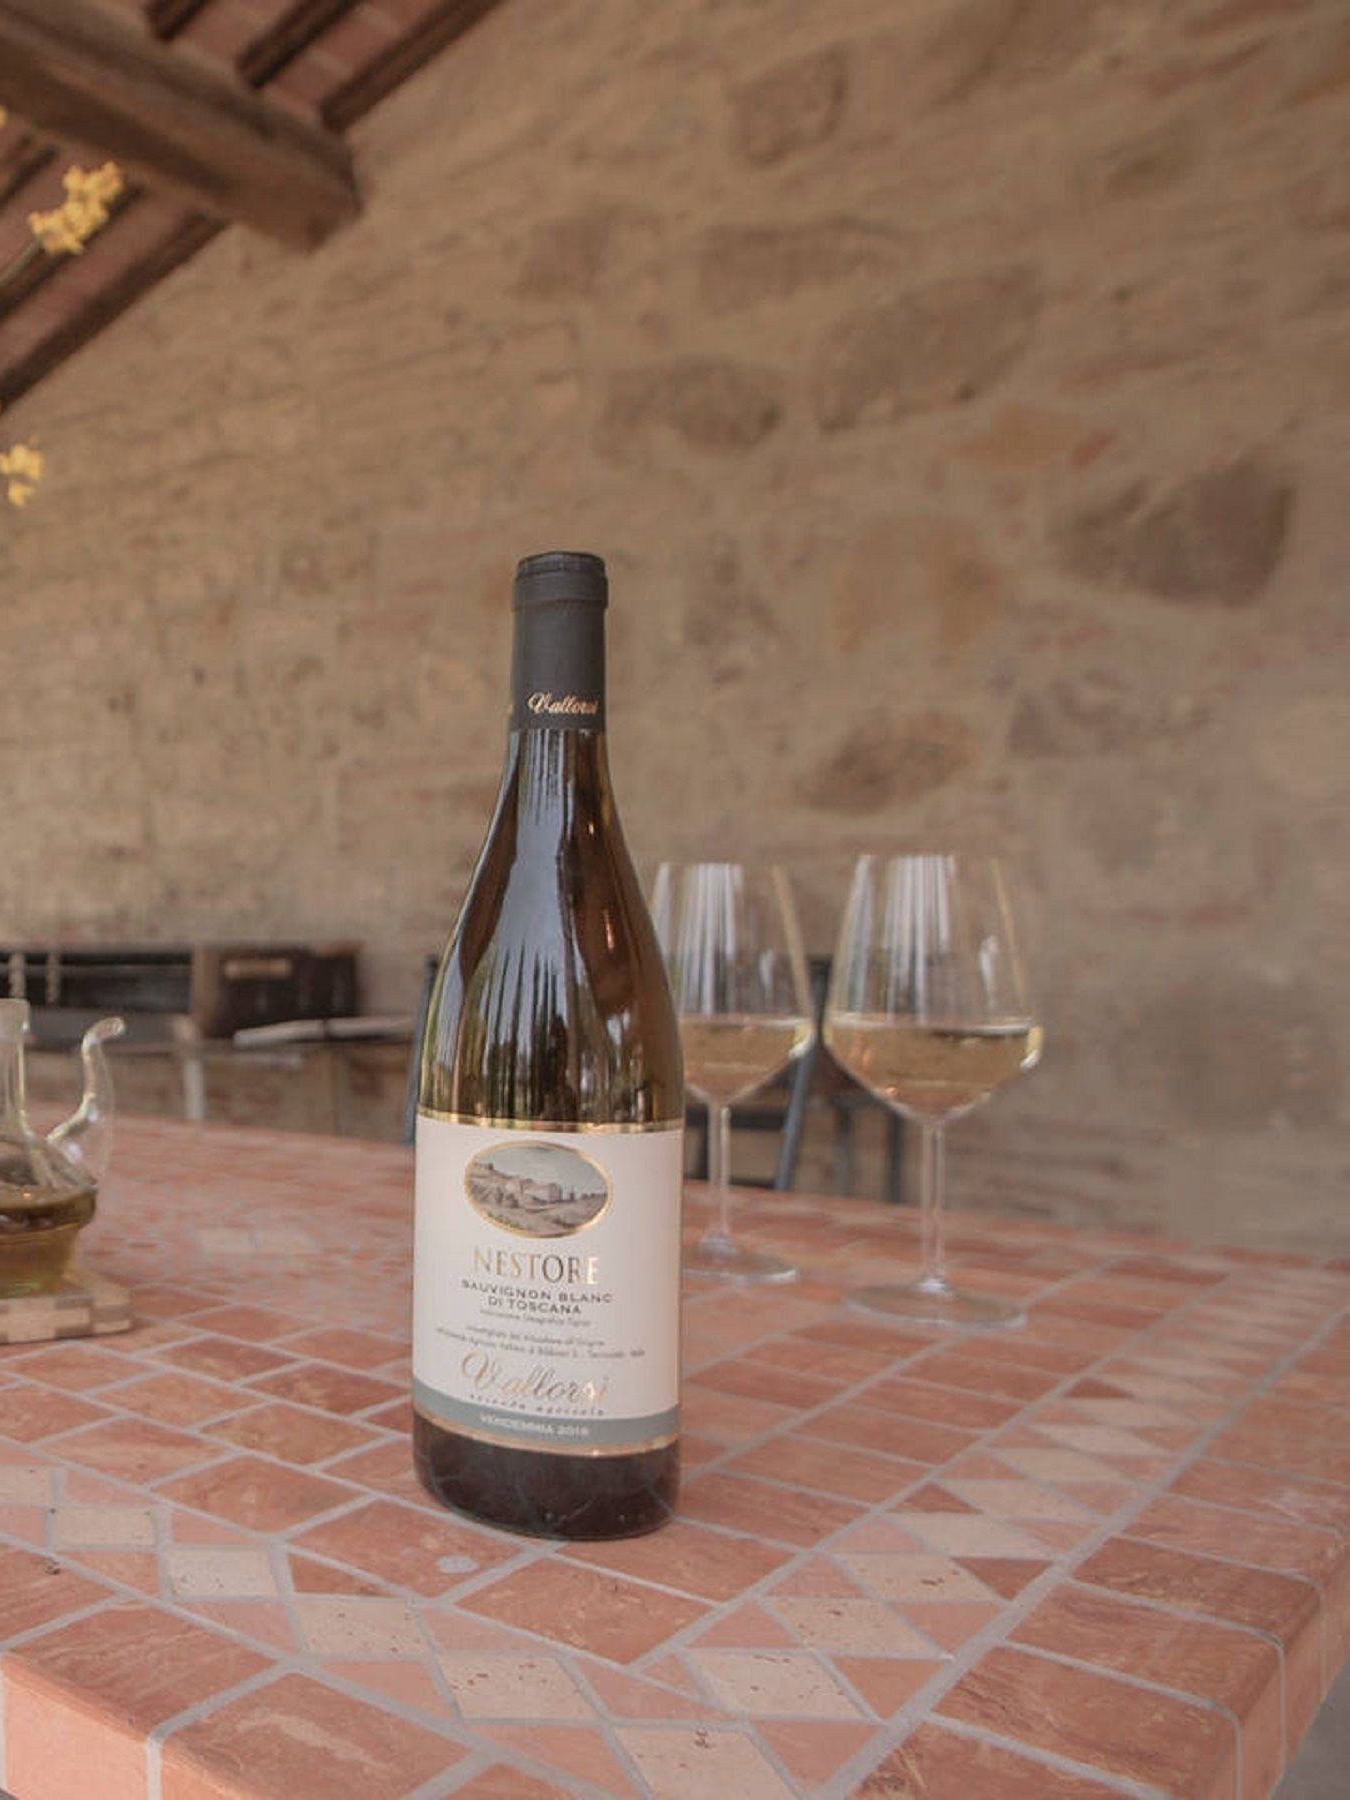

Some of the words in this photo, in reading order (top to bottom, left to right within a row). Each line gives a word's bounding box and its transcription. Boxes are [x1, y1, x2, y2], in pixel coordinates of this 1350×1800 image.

[473, 1247, 599, 1285] NESTORE
[461, 1279, 552, 1300] SAUVIGNON
[558, 1292, 613, 1304] BLANC
[488, 1296, 503, 1307] DI
[509, 1299, 582, 1315] TOSCANA
[461, 1351, 610, 1401] Vallorsi
